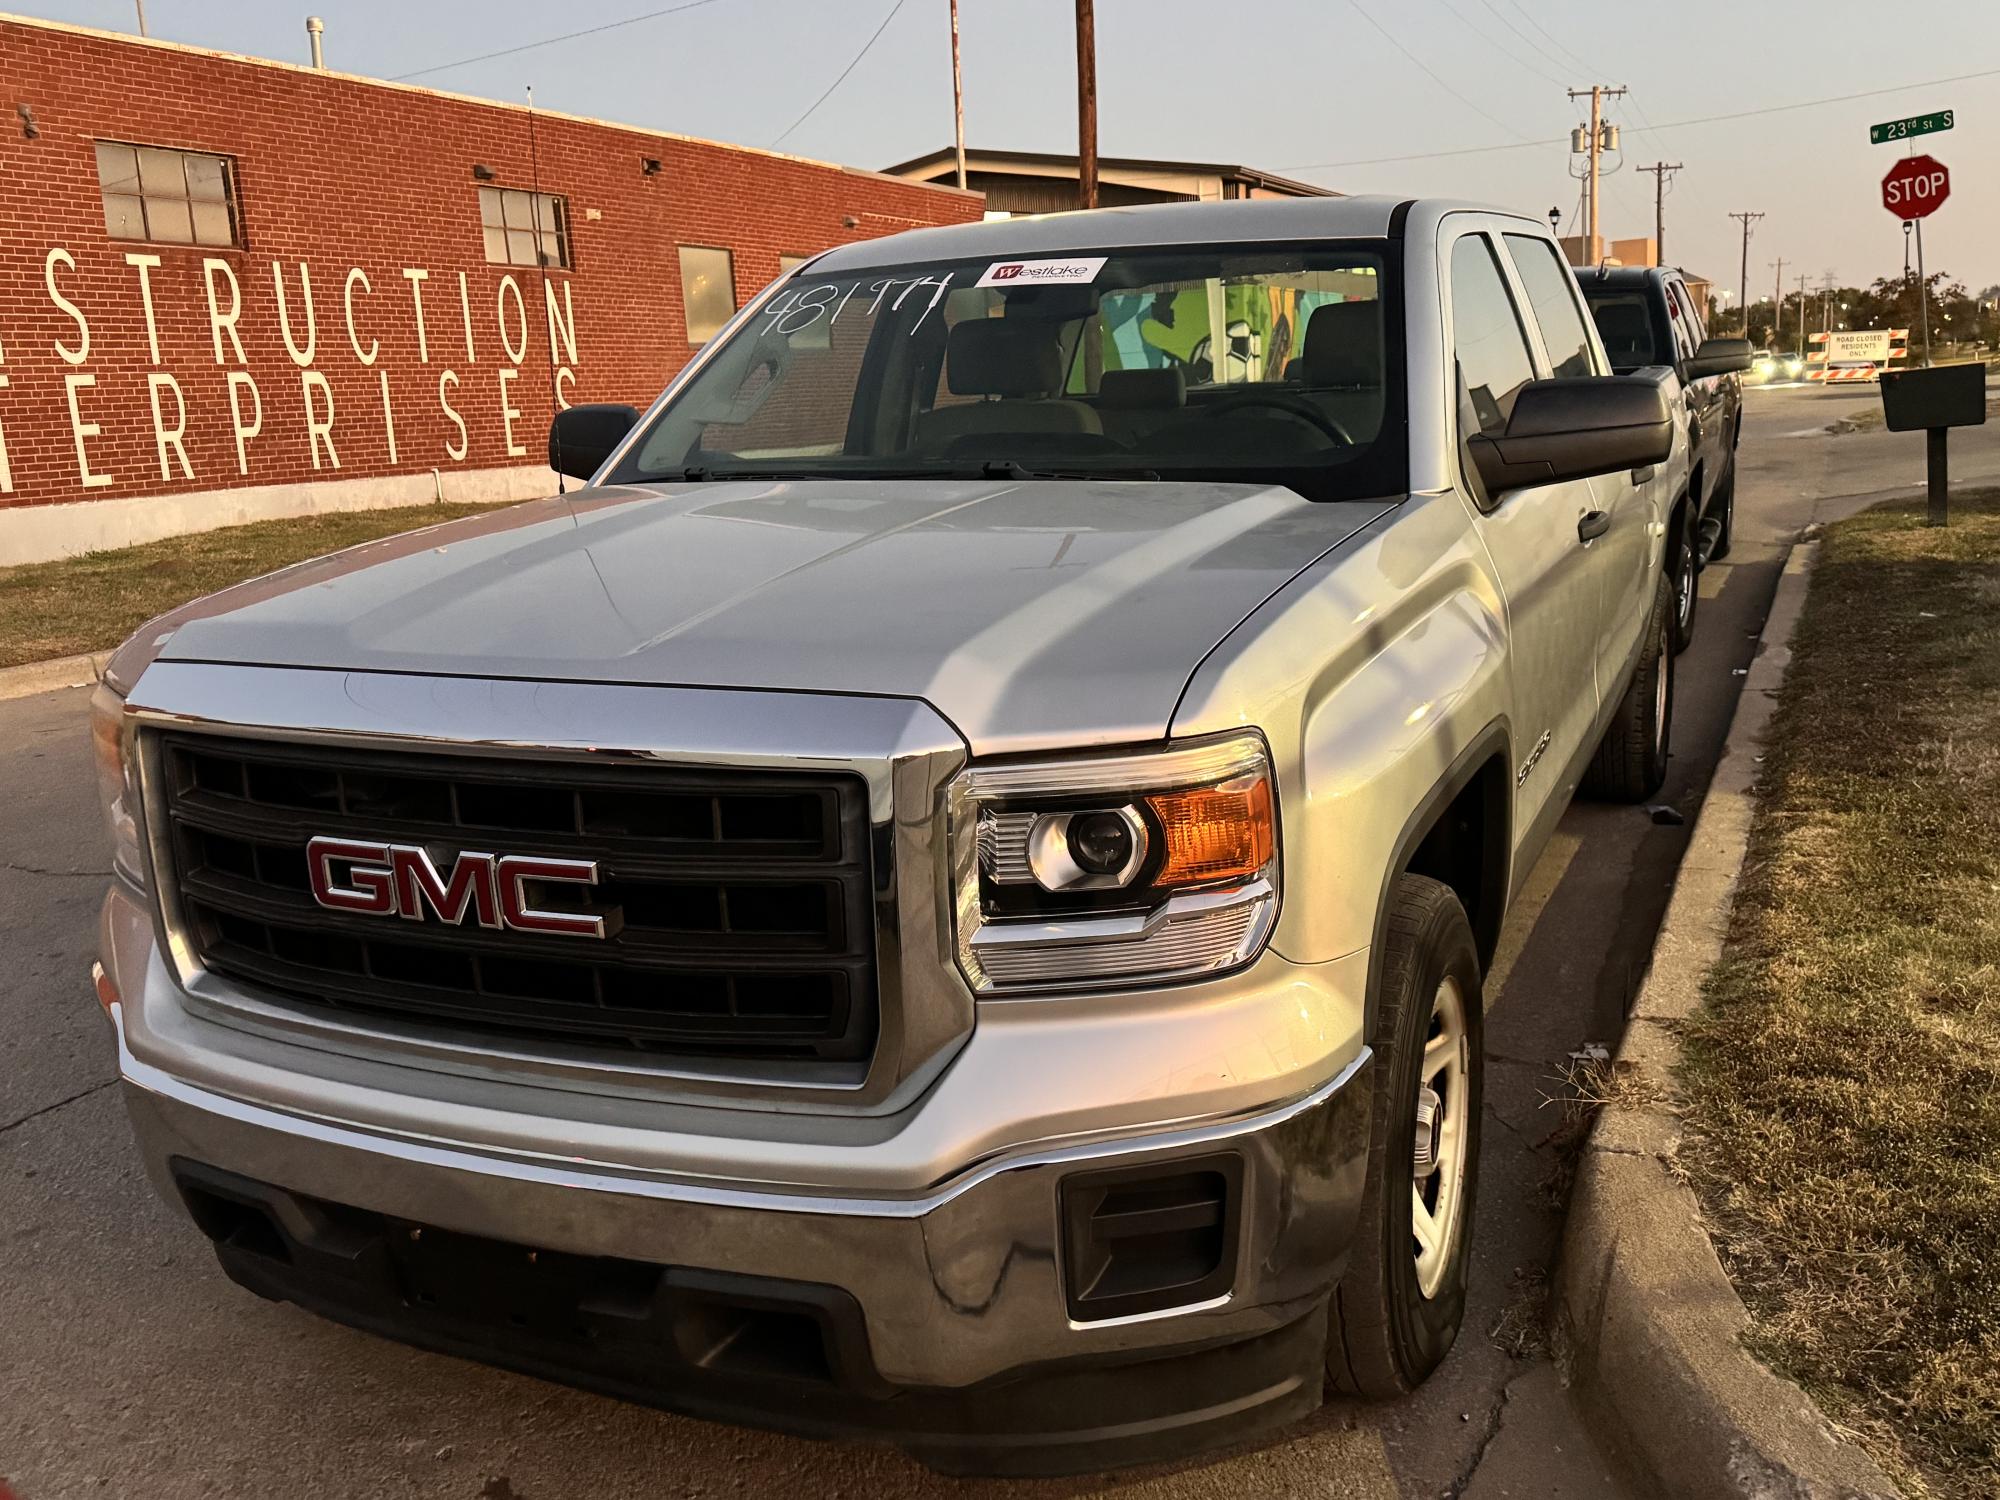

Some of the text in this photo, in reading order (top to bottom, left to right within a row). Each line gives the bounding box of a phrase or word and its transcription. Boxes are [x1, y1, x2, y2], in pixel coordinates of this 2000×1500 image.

[1872, 112, 1952, 139] W 23rd St S
[1887, 172, 1945, 204] STOP
[1000, 265, 1088, 278] Westlake
[0, 248, 579, 366] STRUCTION
[306, 835, 606, 939] GMC
